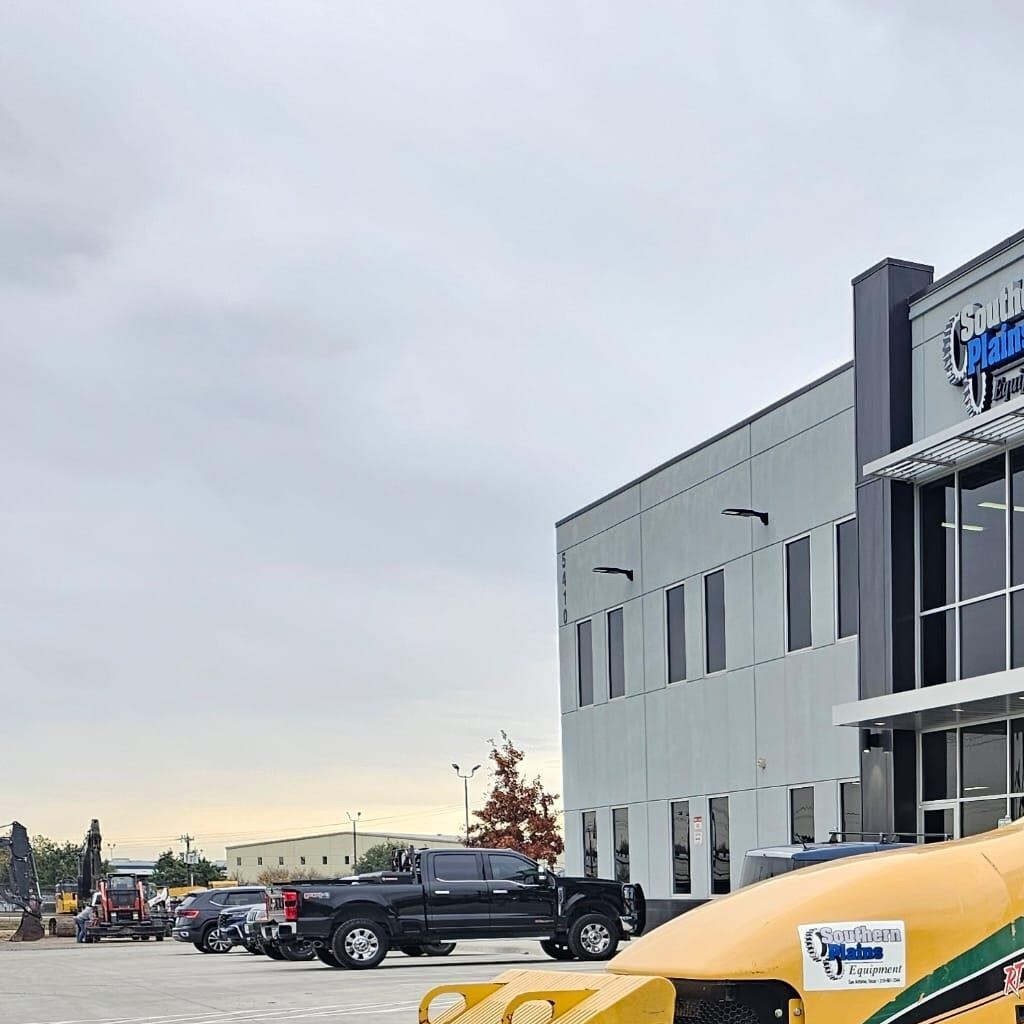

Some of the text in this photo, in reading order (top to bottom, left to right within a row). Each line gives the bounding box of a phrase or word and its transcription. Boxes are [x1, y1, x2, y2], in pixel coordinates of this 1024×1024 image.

[820, 925, 902, 944] Southern
[827, 942, 884, 961] Plains
[849, 965, 902, 978] Equipment
